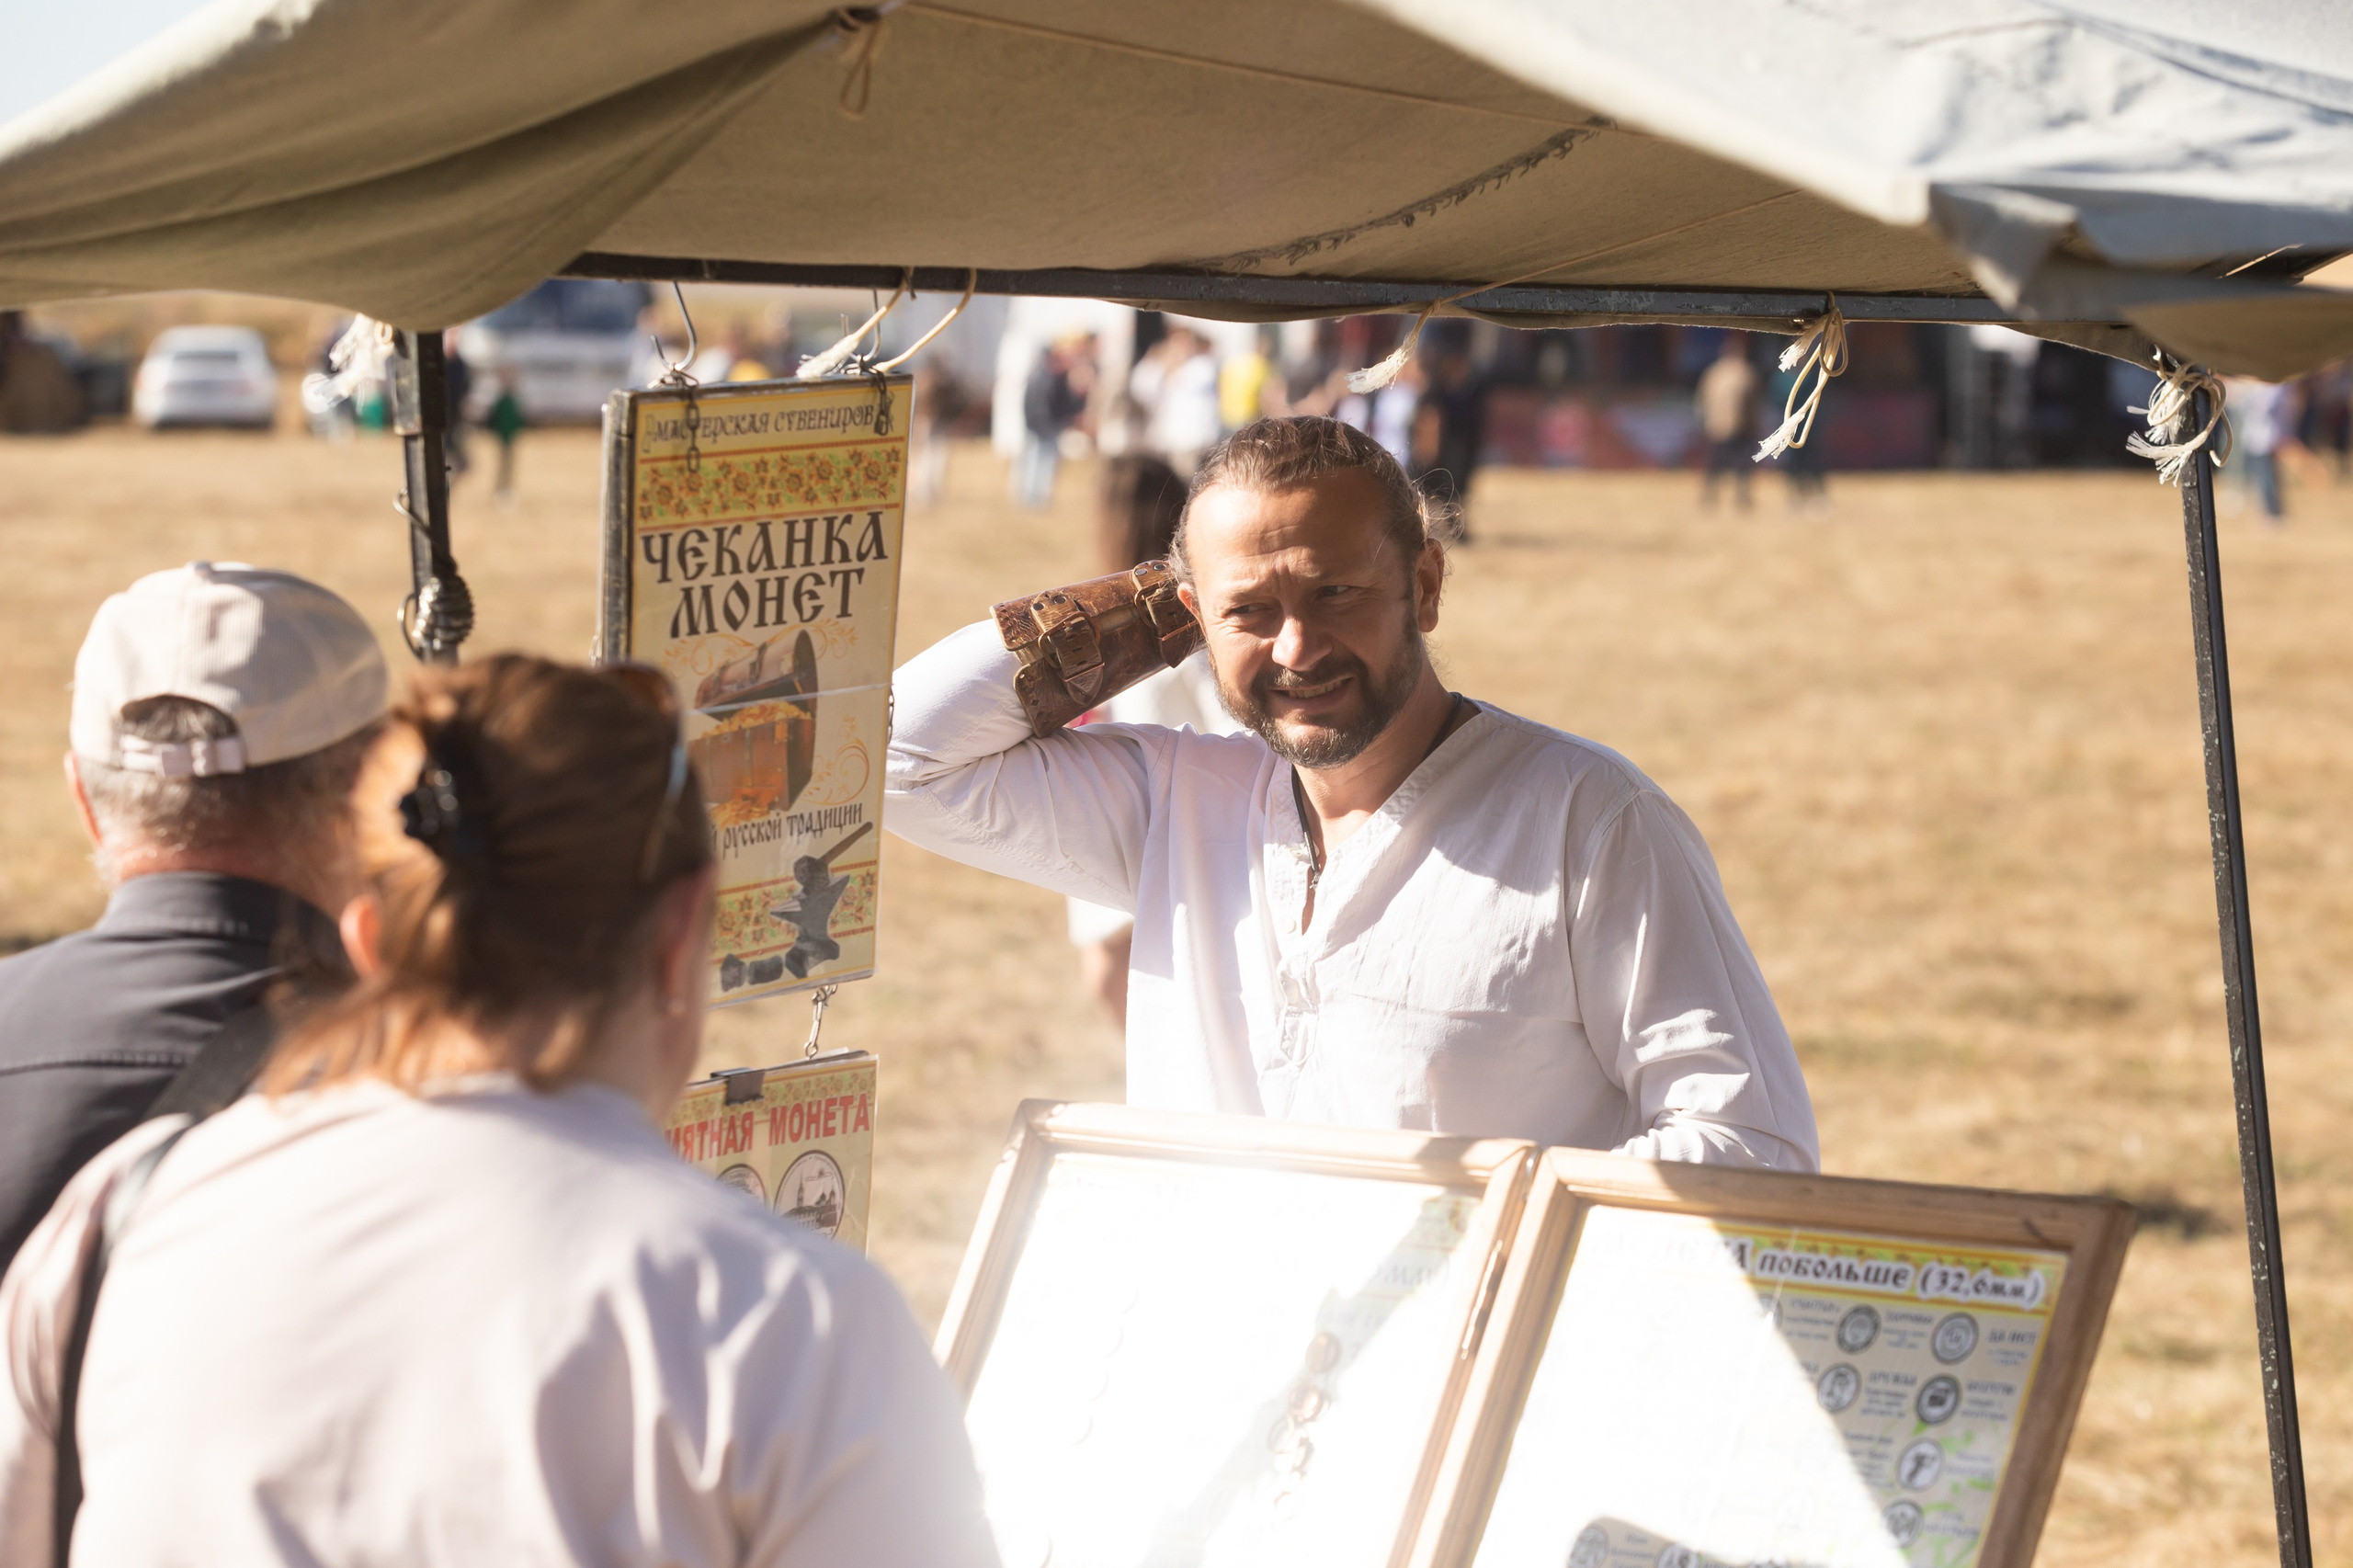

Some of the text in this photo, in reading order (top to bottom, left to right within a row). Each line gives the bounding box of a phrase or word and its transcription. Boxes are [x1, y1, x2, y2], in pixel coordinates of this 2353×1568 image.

[654, 412, 770, 445] МАСЕРСКАЯ
[642, 511, 889, 585] ЧЕКАНКА
[670, 568, 866, 639] МОНЕТ
[722, 812, 783, 860] русской
[787, 802, 863, 845] традиции
[769, 1093, 870, 1147] МОНЕТА
[1758, 1251, 1910, 1289] побольше
